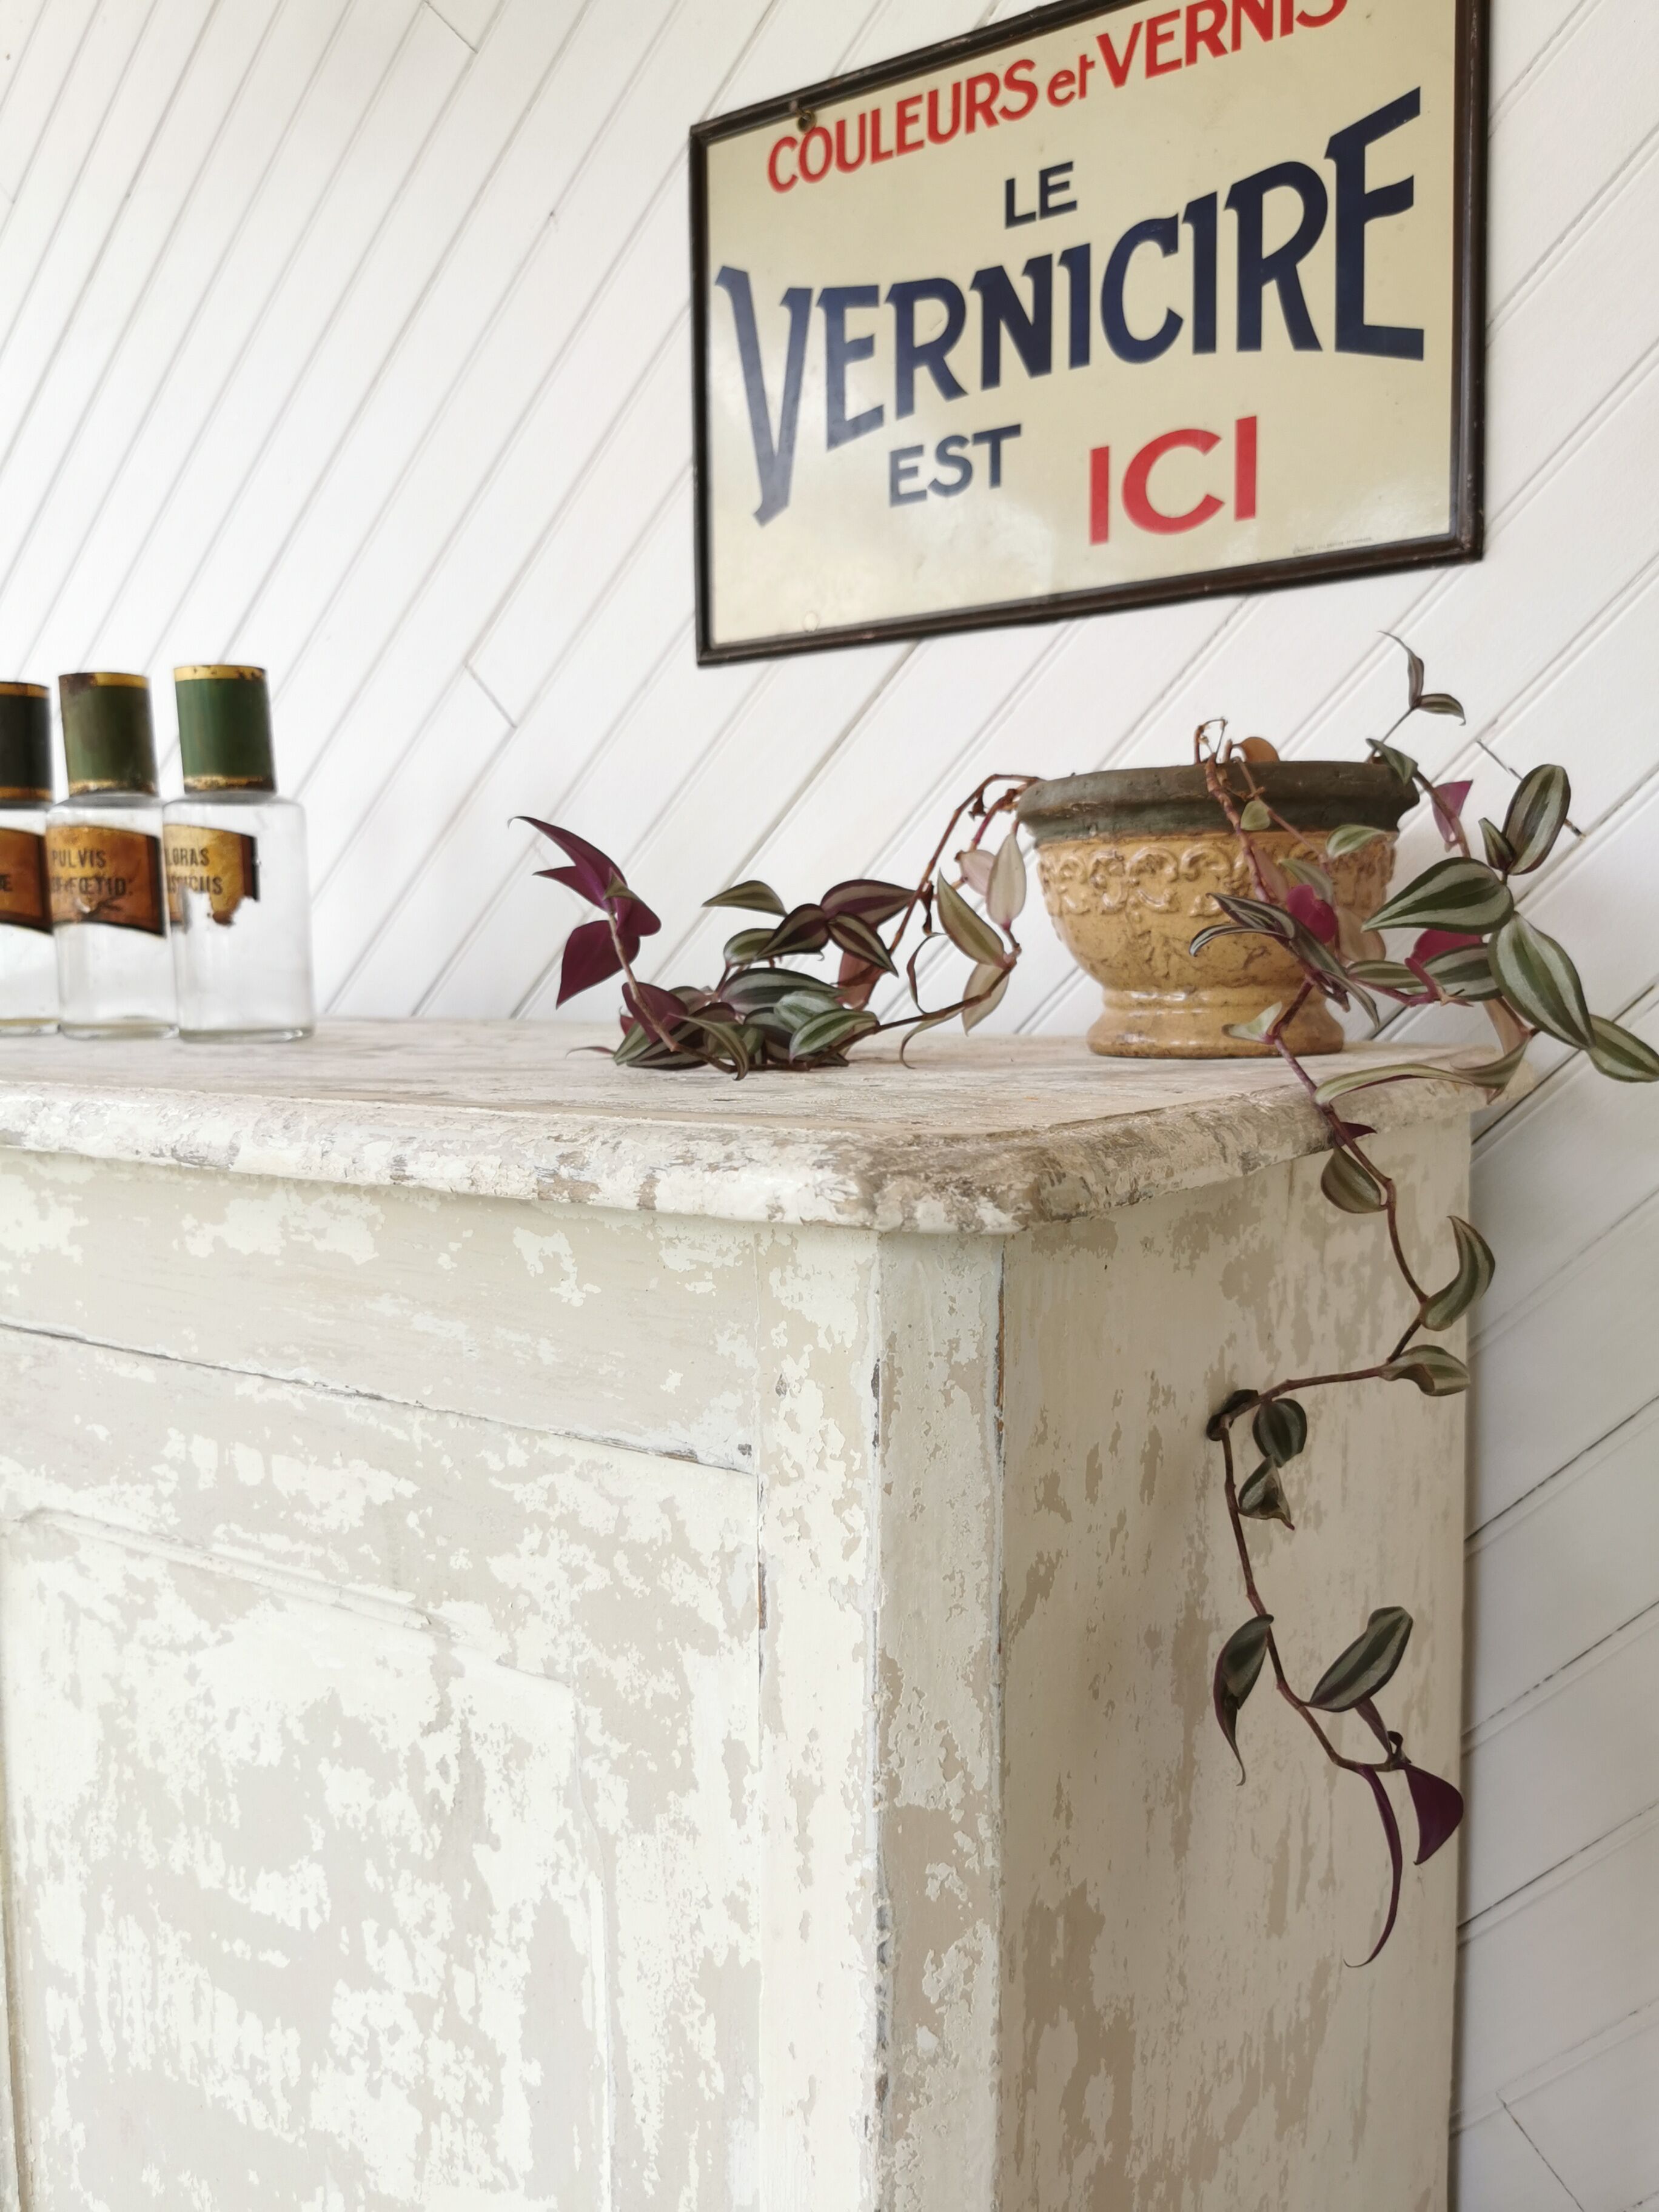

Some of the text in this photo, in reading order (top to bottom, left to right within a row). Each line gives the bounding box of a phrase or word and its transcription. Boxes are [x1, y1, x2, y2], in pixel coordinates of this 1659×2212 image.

[768, 59, 1039, 192] COULEURS
[1047, 55, 1095, 107] et
[1004, 161, 1077, 229] LE
[716, 86, 1424, 528] VERNICIRE
[888, 417, 1257, 544] EST ICI
[52, 848, 106, 868] PULVIS
